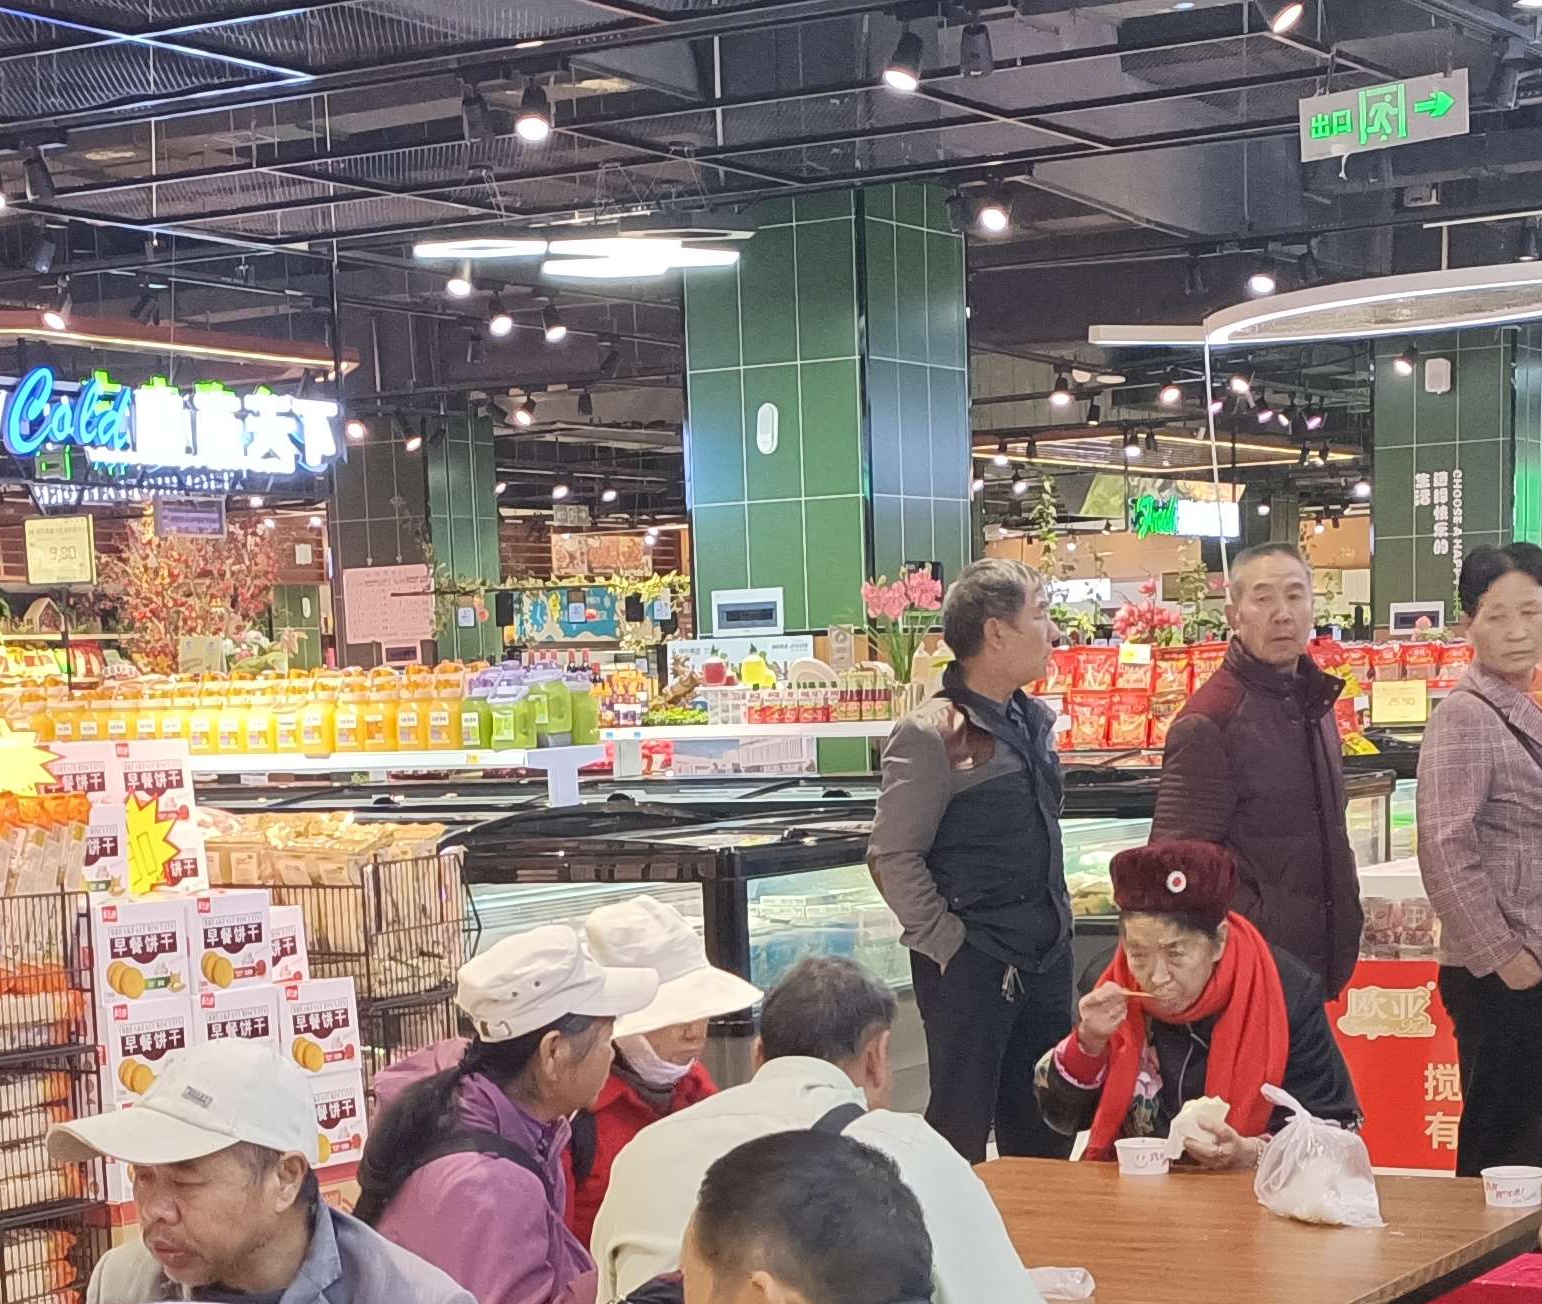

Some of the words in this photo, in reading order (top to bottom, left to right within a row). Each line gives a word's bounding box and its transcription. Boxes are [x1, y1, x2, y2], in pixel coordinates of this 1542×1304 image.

[1311, 109, 1353, 139] 出口
[5, 366, 131, 455] Cold
[127, 771, 181, 790] 早餐饼干
[113, 934, 174, 956] 早餐饼干
[206, 924, 260, 945] 早餐饼干
[1348, 987, 1431, 1021] 欧亚
[211, 1018, 267, 1040] 早餐饼干
[294, 1010, 347, 1032] 早餐饼干
[125, 1031, 182, 1053] 早餐饼干
[1424, 1111, 1458, 1151] 有
